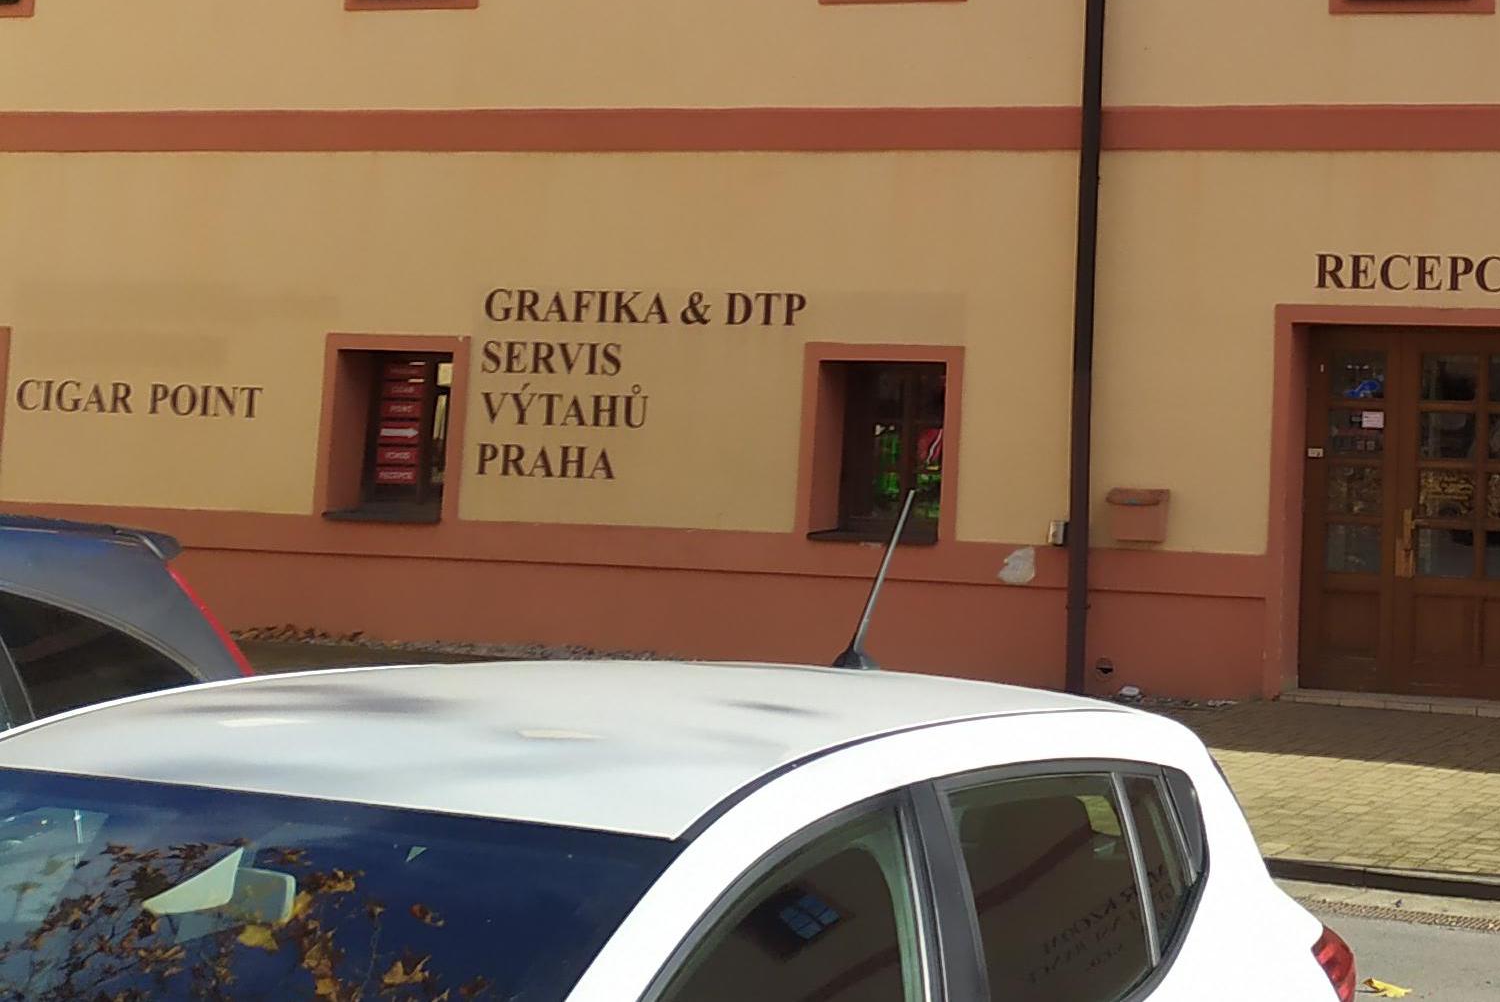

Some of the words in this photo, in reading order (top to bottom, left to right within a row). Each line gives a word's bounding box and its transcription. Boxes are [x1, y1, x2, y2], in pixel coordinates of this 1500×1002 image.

[484, 288, 669, 325] GRAFIKA
[680, 291, 712, 324] &
[724, 291, 806, 327] DTP
[481, 341, 622, 376] SERVIS
[16, 378, 132, 415] CIGAR
[148, 384, 263, 419] POINT
[481, 383, 648, 429] VÝTAHŮ
[476, 444, 615, 480] PRAHA
